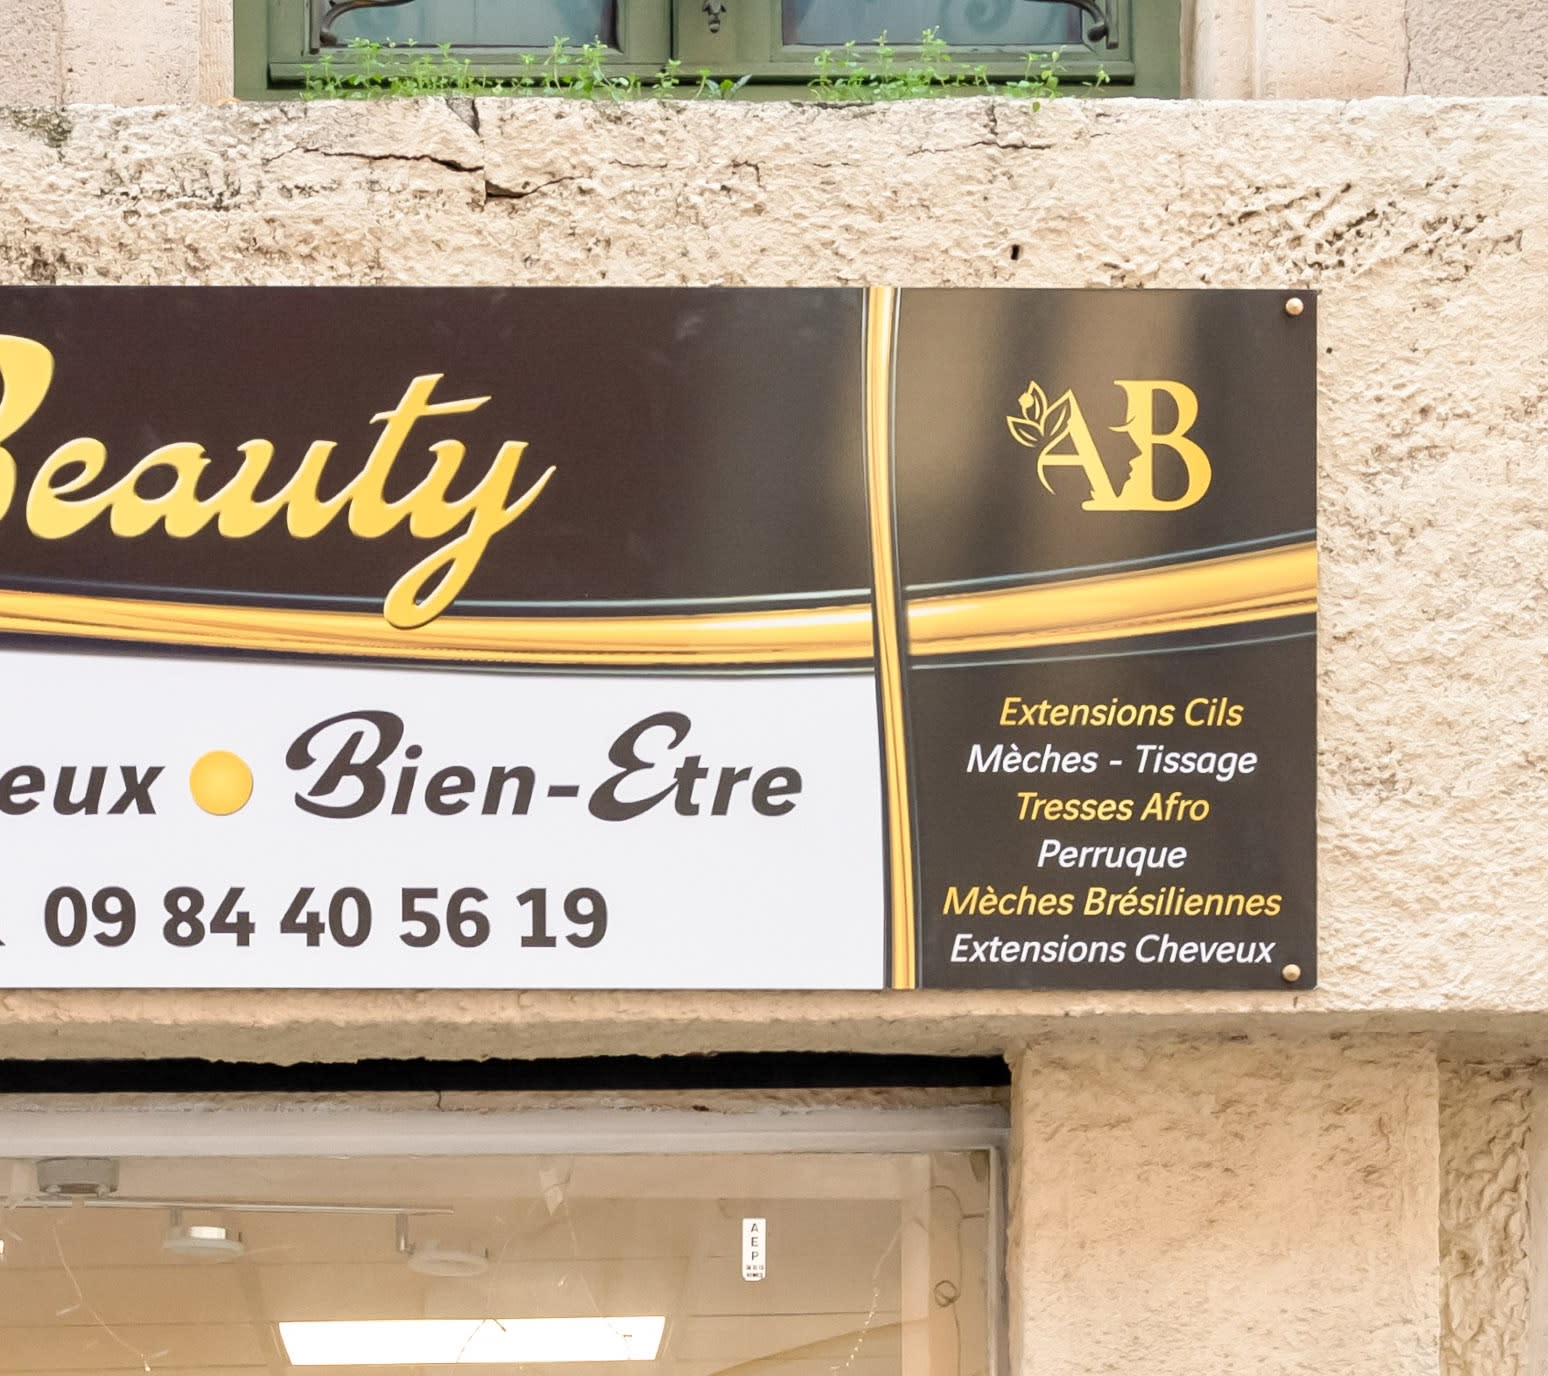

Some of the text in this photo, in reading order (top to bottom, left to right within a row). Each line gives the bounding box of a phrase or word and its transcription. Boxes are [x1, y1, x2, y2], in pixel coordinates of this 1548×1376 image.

[999, 696, 1245, 727] Extensions Cils
[285, 709, 803, 822] Bien-Etre
[966, 743, 1099, 774] Mèches
[1136, 744, 1258, 782] Tissage
[1017, 791, 1210, 821] Tresses Afro
[1037, 839, 1188, 877] Perruque
[44, 886, 137, 948] 09
[162, 886, 256, 948] 84
[279, 886, 372, 948] 40
[399, 886, 491, 948] 56
[516, 887, 608, 949] 19
[942, 885, 1283, 916] Mèches Brésiliennes
[950, 933, 1277, 964] Extensions Cheveux
